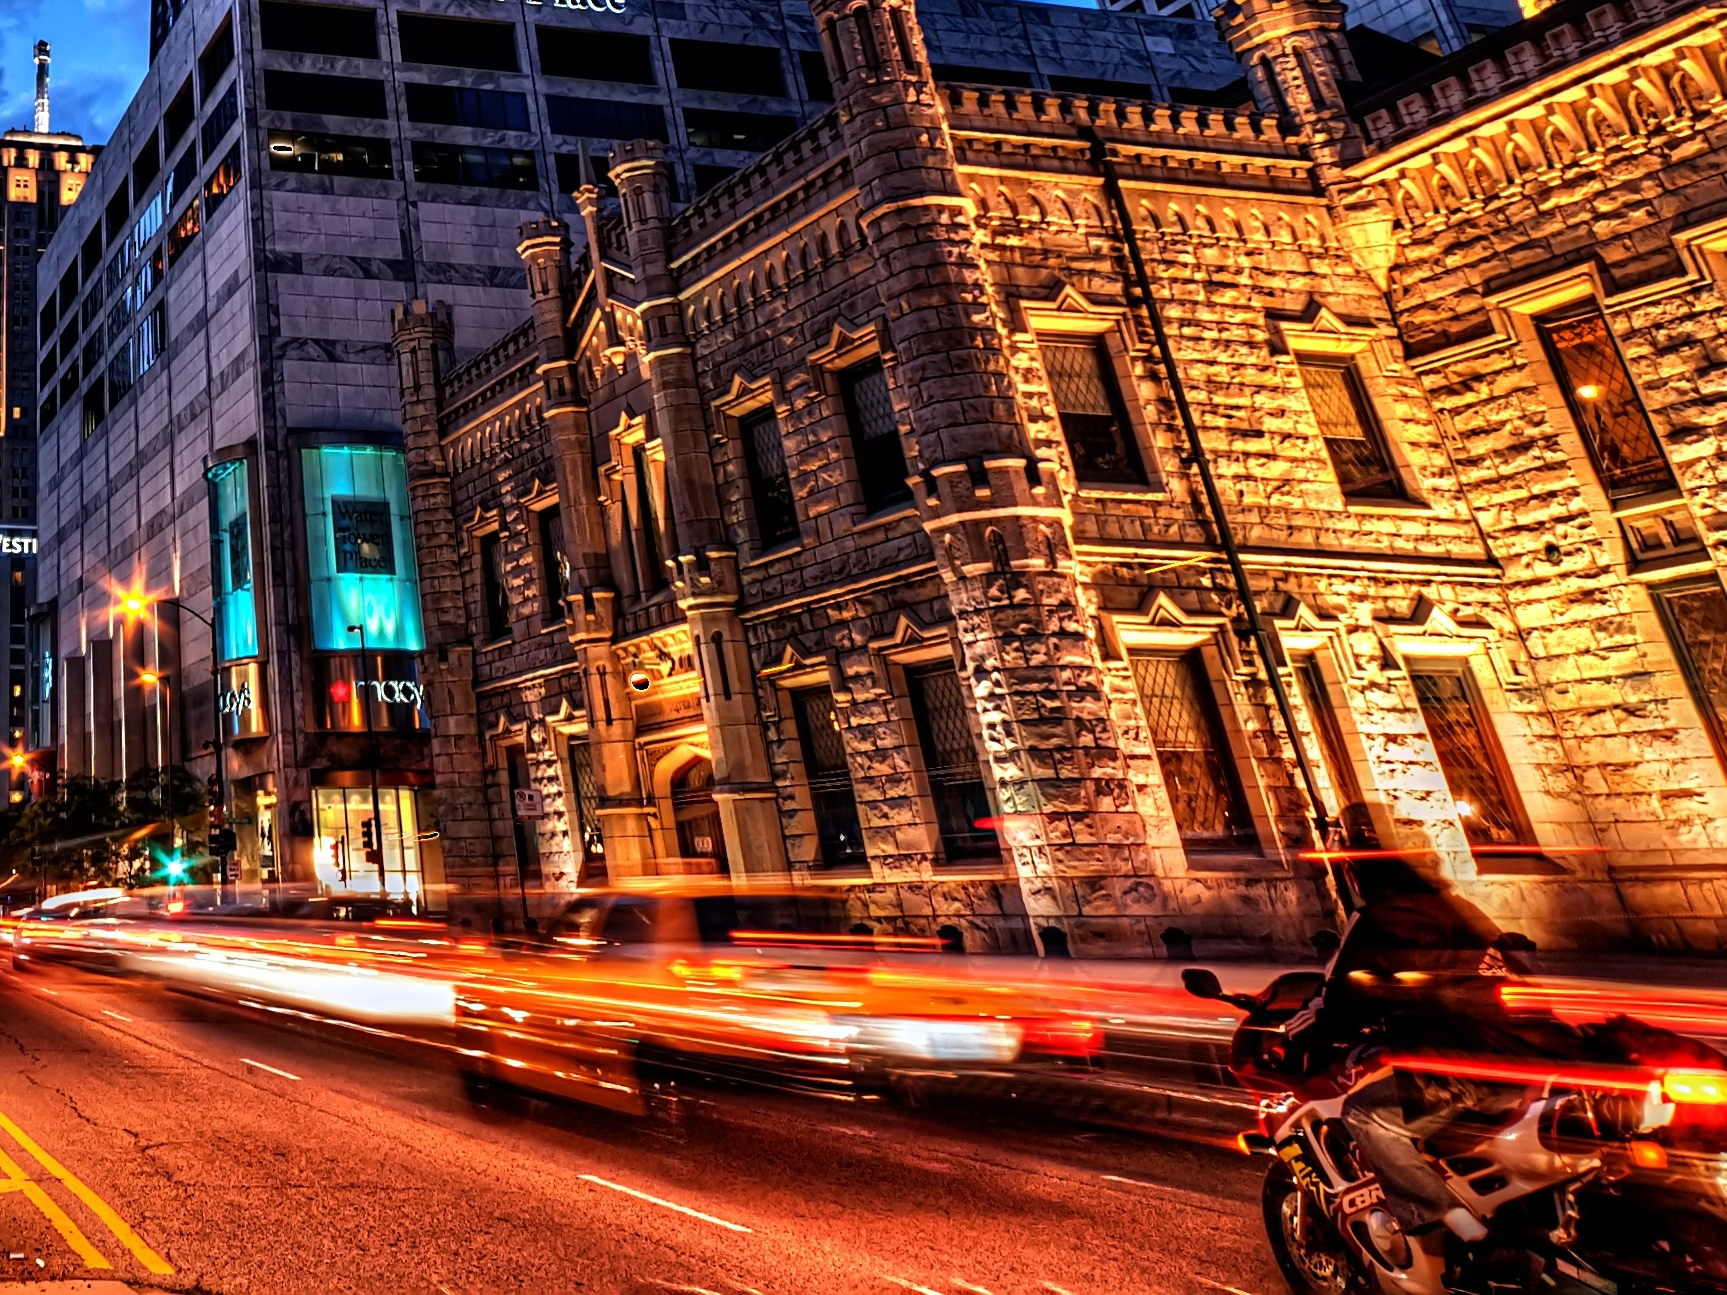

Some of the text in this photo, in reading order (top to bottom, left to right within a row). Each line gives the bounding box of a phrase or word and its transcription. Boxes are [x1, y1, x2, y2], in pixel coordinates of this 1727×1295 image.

[337, 504, 386, 523] Water
[337, 527, 386, 546] Tower
[342, 550, 386, 569] Place
[356, 680, 425, 710] macy
[1342, 1183, 1386, 1214] CBR
